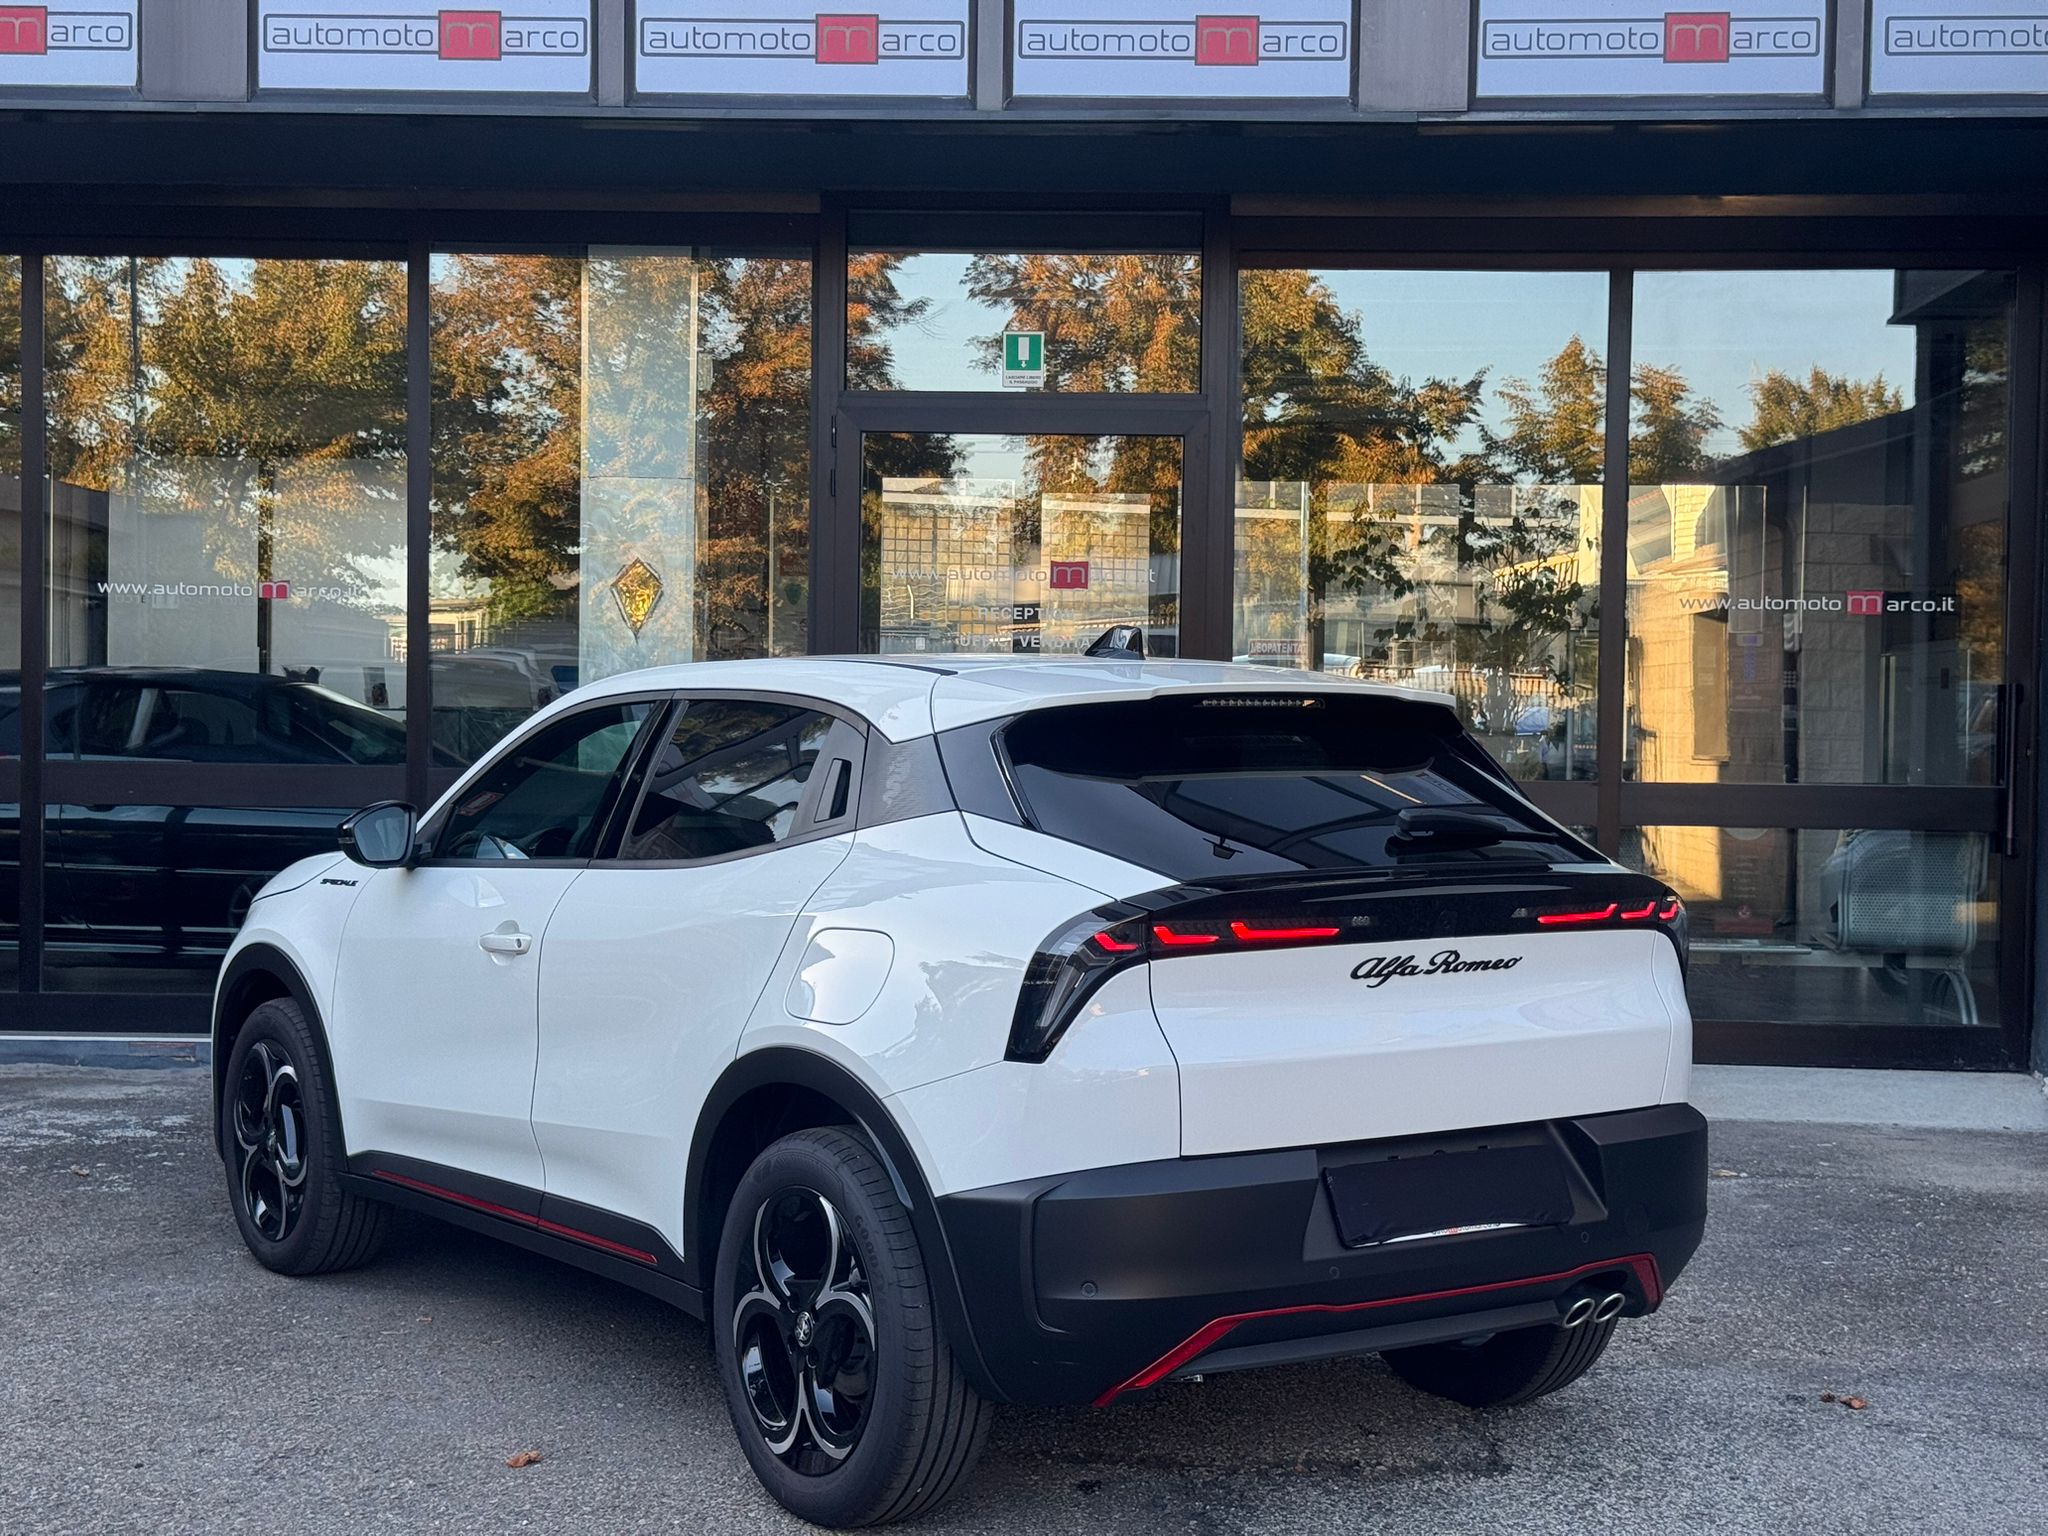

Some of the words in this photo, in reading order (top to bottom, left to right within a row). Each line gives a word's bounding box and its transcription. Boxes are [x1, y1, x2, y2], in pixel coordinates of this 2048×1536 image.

[1894, 24, 2048, 48] automot
[1350, 955, 1424, 988] Alfa
[1423, 949, 1523, 975] Romeo
